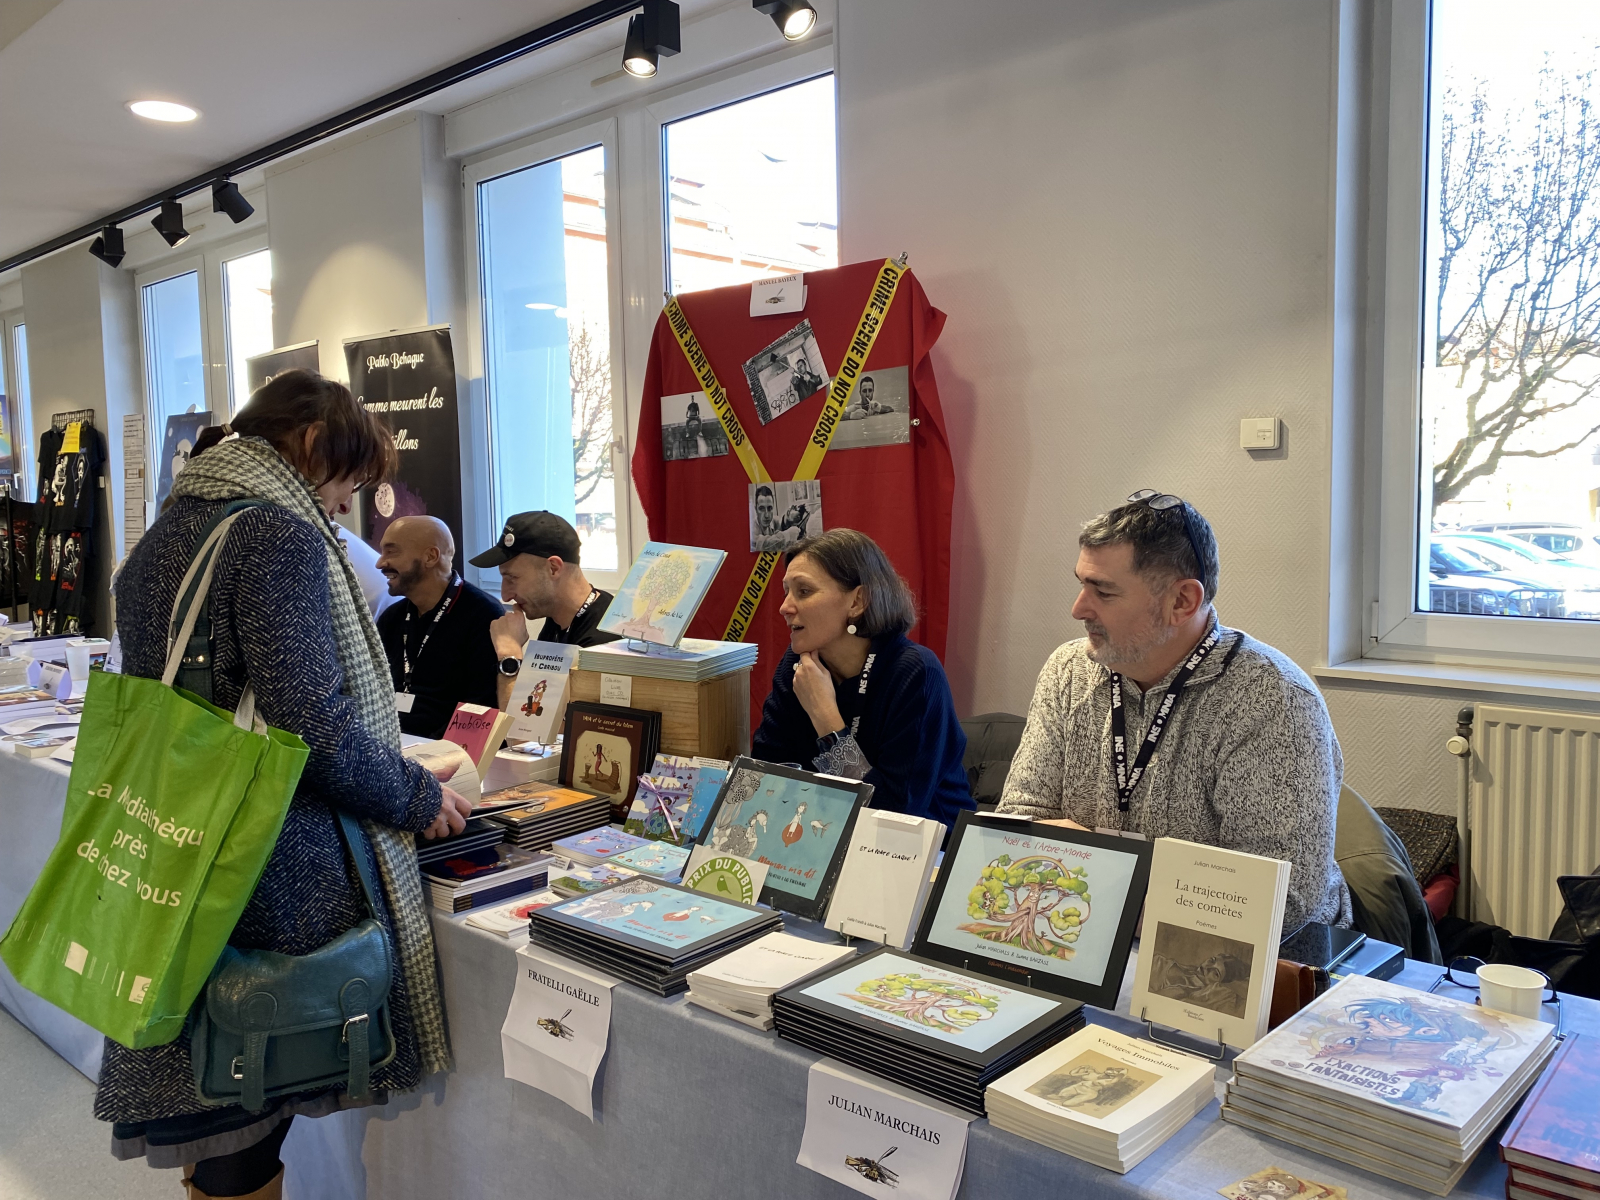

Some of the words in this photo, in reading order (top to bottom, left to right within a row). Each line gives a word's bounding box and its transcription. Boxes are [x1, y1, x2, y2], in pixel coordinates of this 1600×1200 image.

[778, 275, 797, 283] BAYEUX
[870, 267, 899, 315] CRIME
[851, 313, 879, 359] SCENE
[367, 354, 389, 374] Pablo
[390, 351, 424, 369] Behague
[668, 301, 690, 339] CRIME
[684, 335, 708, 373] SCENE
[701, 368, 715, 389] DO
[710, 386, 727, 410] NOT
[721, 407, 745, 447] CROSS
[842, 356, 860, 379] DO
[390, 392, 428, 412] meurent
[428, 386, 444, 408] les
[831, 378, 852, 407] NOT
[813, 404, 839, 449] CROSS
[747, 579, 762, 600] DO
[737, 596, 755, 623] NOT
[724, 618, 745, 642] CRO
[448, 712, 491, 731] Arob@se
[110, 829, 148, 860] près
[874, 849, 890, 857] PORTE
[891, 853, 911, 862] CLAQUE
[77, 839, 99, 863] de
[136, 877, 182, 907] vous
[687, 862, 712, 889] PRIX
[715, 858, 732, 869] DU
[1193, 860, 1210, 870] Julian
[1210, 863, 1236, 874] Marchais
[1175, 879, 1189, 892] La
[1192, 883, 1248, 905] trajectoire
[1176, 895, 1194, 908] des
[1197, 901, 1243, 919] comètes
[528, 969, 565, 993] FRATELLI
[565, 985, 600, 1007] GAËLLE
[1097, 1038, 1132, 1055] Voyages
[1132, 1052, 1181, 1072] Immobiles
[1304, 1062, 1401, 1096] FANTAISISTES
[1324, 1057, 1401, 1085] EXACTIONS
[828, 1094, 873, 1120] JULIAN
[874, 1110, 941, 1146] MARCHAIS
